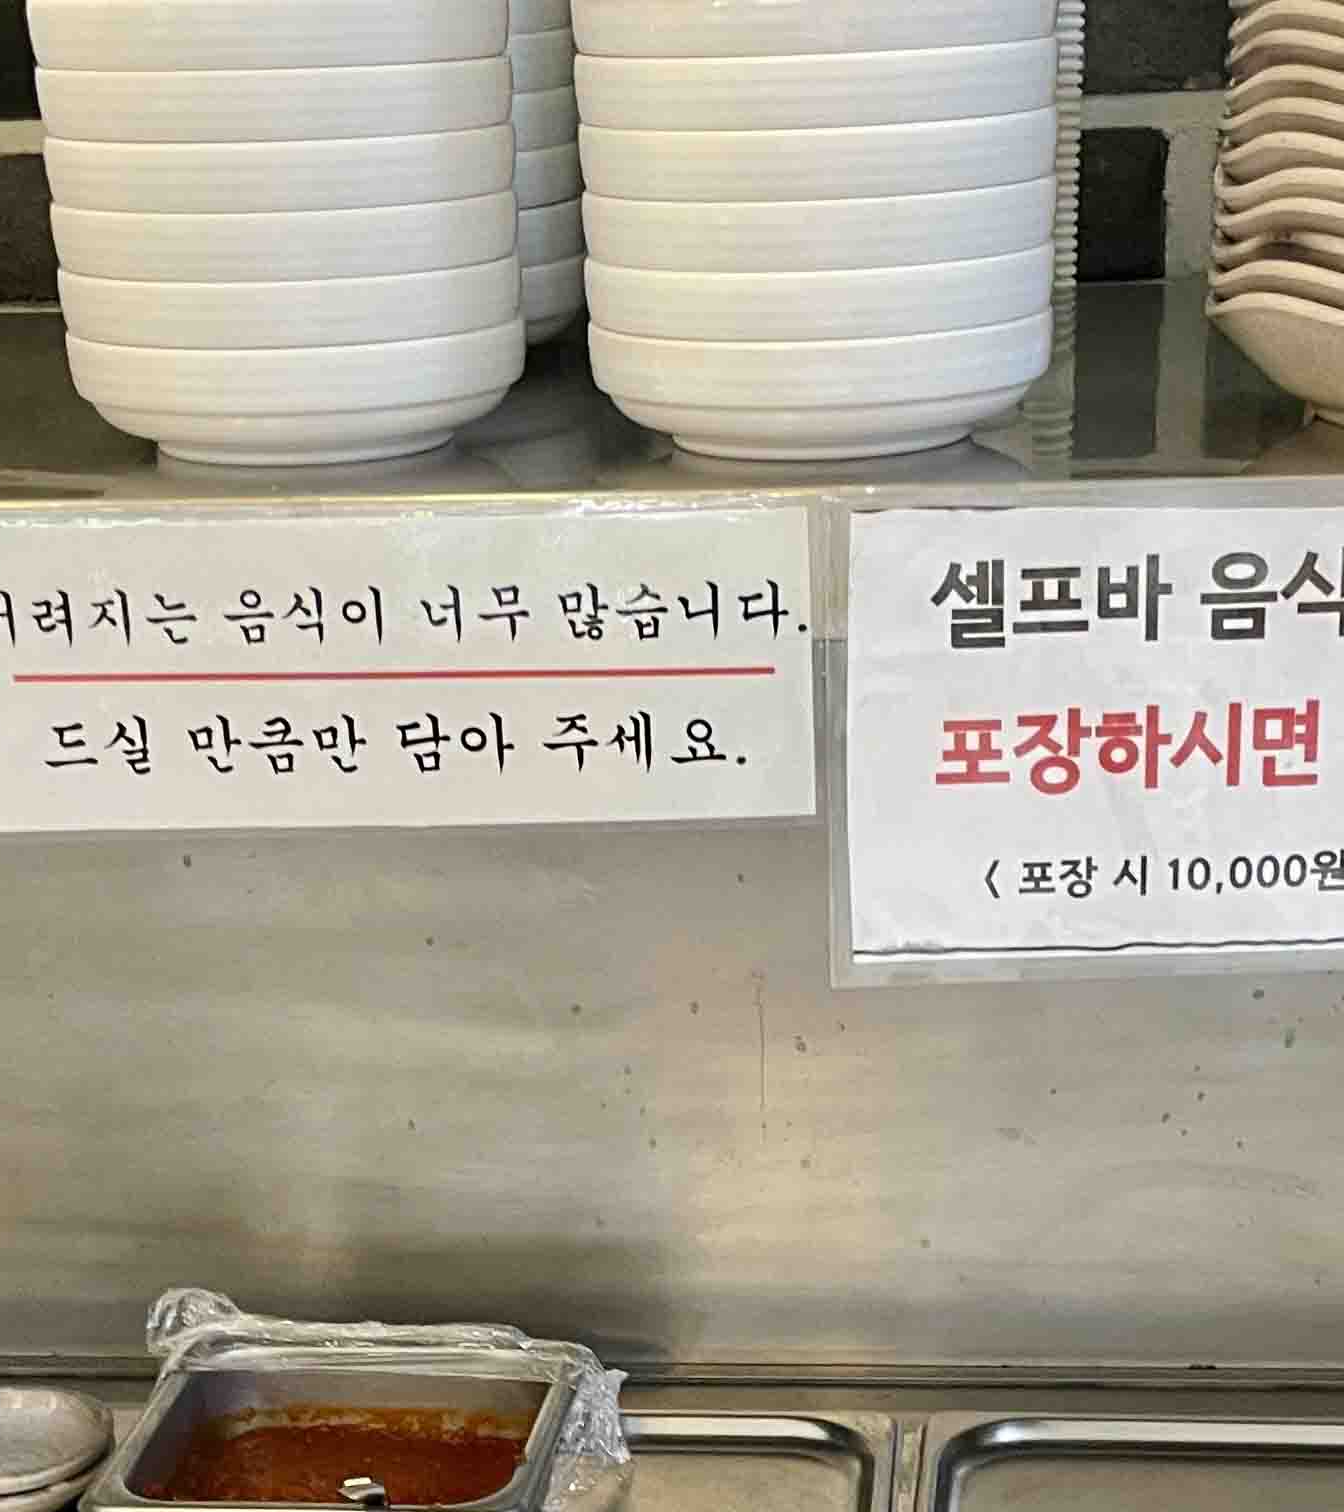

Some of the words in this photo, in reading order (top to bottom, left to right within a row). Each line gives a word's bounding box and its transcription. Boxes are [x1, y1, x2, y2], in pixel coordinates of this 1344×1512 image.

[224, 586, 384, 645] 음식이
[420, 585, 531, 643] 너무
[558, 580, 808, 642] 많습니다.
[930, 554, 1172, 649] 셀프바
[44, 715, 152, 775] 드실
[187, 713, 367, 775] 만큼만
[396, 712, 515, 774] 담아
[543, 711, 747, 772] 주세요.
[934, 698, 1321, 796] 포장하시면
[1018, 856, 1098, 899] 포장
[1113, 855, 1149, 897] 시
